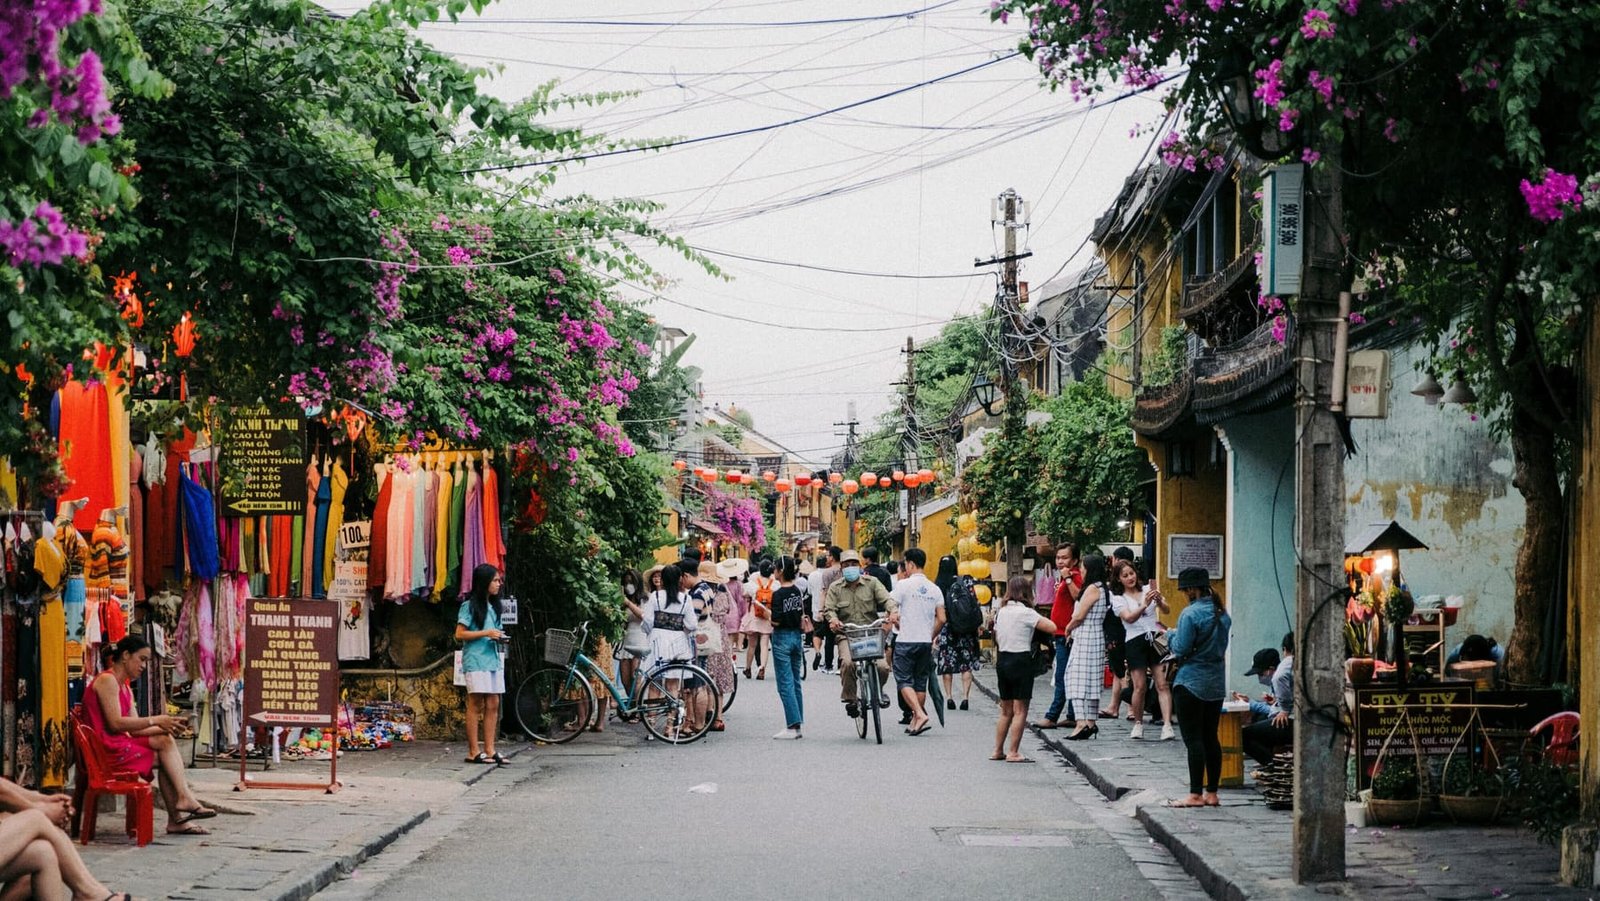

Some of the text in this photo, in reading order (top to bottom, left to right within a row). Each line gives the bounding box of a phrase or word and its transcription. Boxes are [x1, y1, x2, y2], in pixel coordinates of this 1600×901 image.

[342, 525, 362, 544] 100
[250, 614, 333, 629] THANH THANH
[267, 630, 290, 639] CAO
